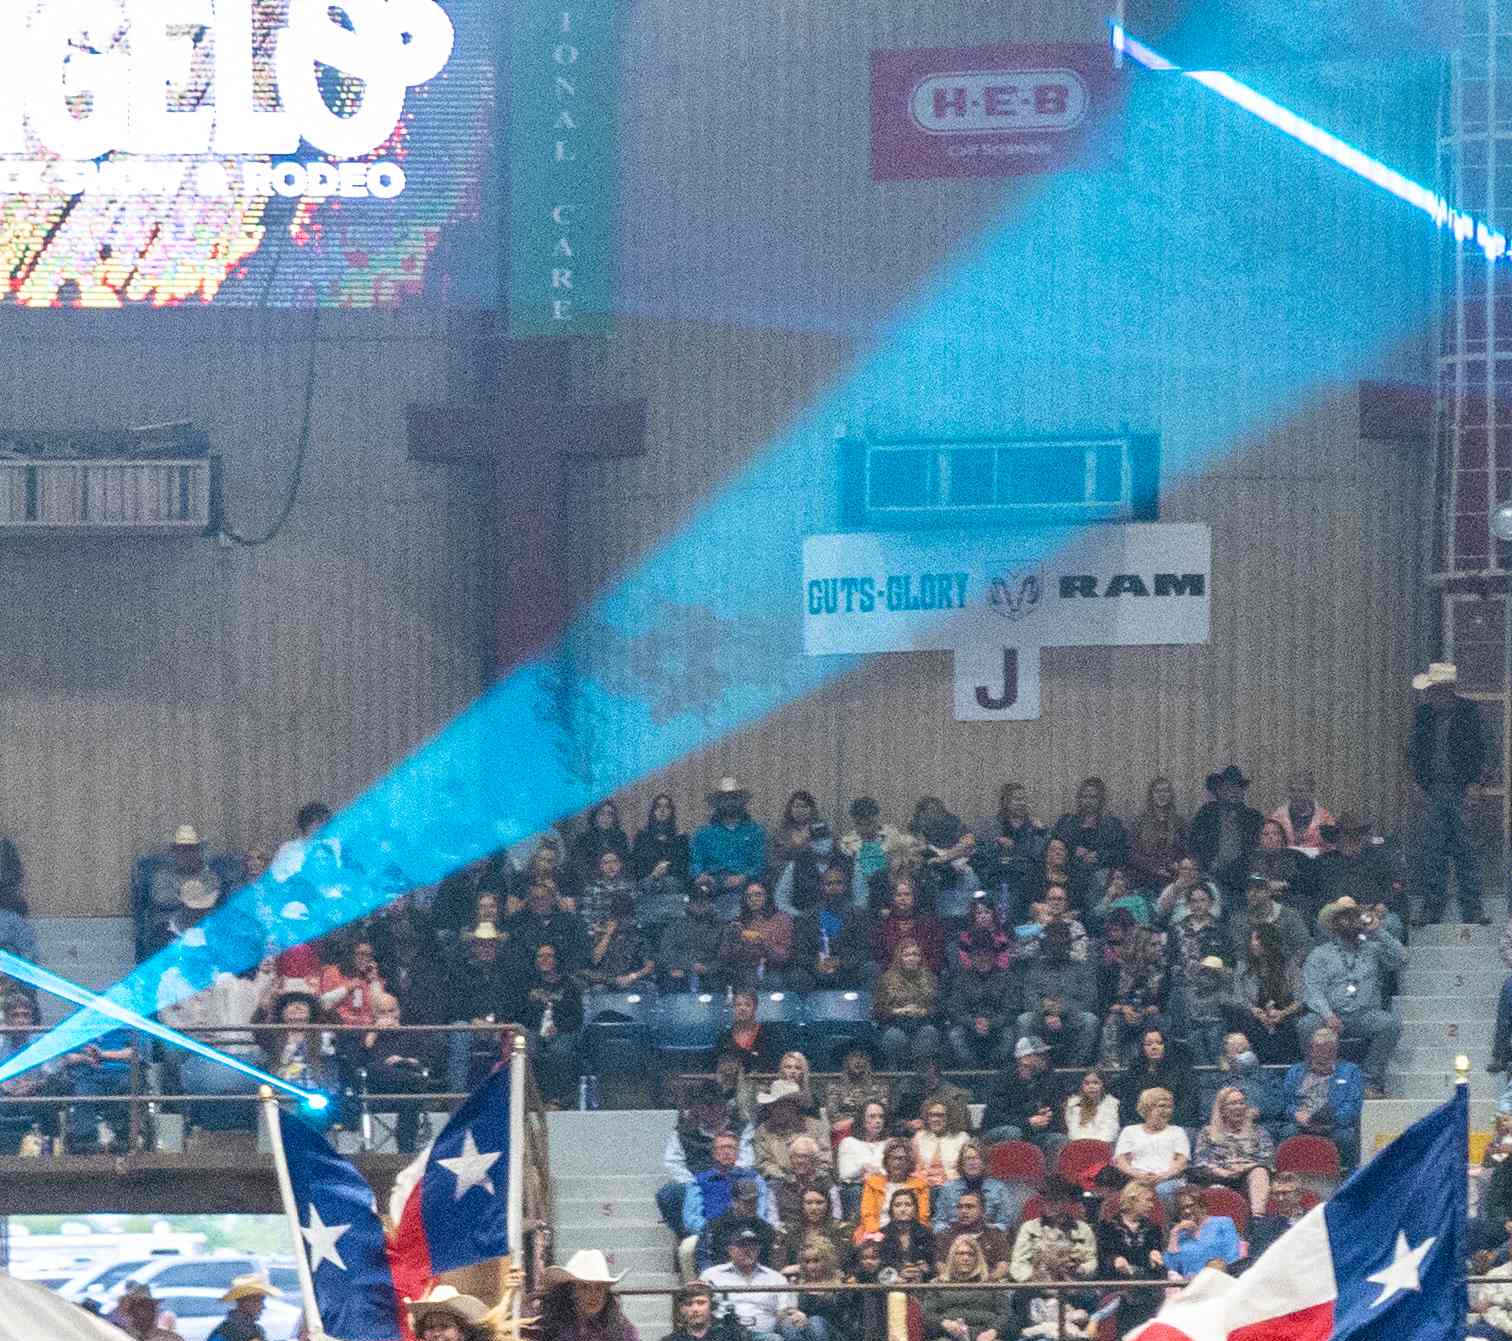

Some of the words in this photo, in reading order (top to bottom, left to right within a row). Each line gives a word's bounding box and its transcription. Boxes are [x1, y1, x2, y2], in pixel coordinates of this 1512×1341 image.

[552, 12, 579, 162] IONAL
[933, 84, 1069, 119] H-E-B
[244, 160, 407, 199] RODEO
[550, 204, 574, 321] CARE
[1058, 573, 1206, 599] RAM
[975, 648, 1018, 710] J
